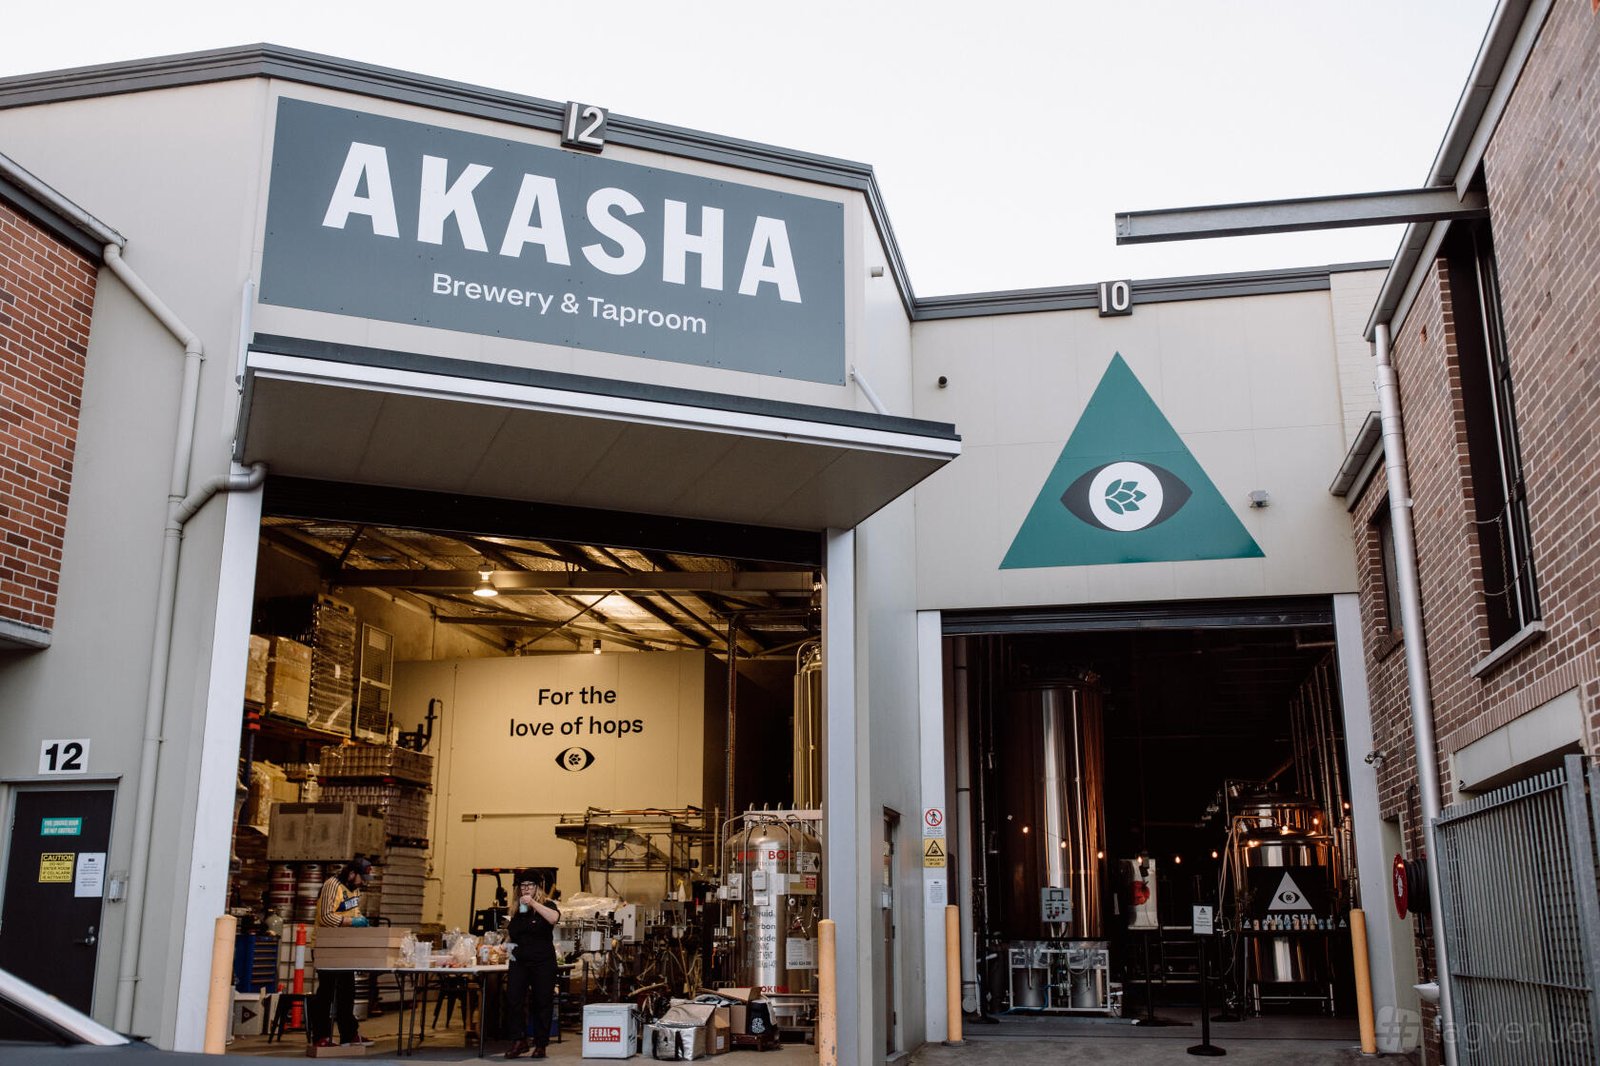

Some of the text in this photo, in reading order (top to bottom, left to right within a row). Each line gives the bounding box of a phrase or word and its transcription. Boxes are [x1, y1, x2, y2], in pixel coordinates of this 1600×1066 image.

[567, 103, 604, 145] 12
[322, 141, 802, 303] AKASHA
[432, 272, 707, 334] Brewery & Taproom
[1100, 281, 1130, 312] 10
[538, 686, 617, 705] For the
[510, 716, 643, 738] love of hops
[45, 742, 83, 771] 12
[590, 1028, 612, 1037] FERAL
